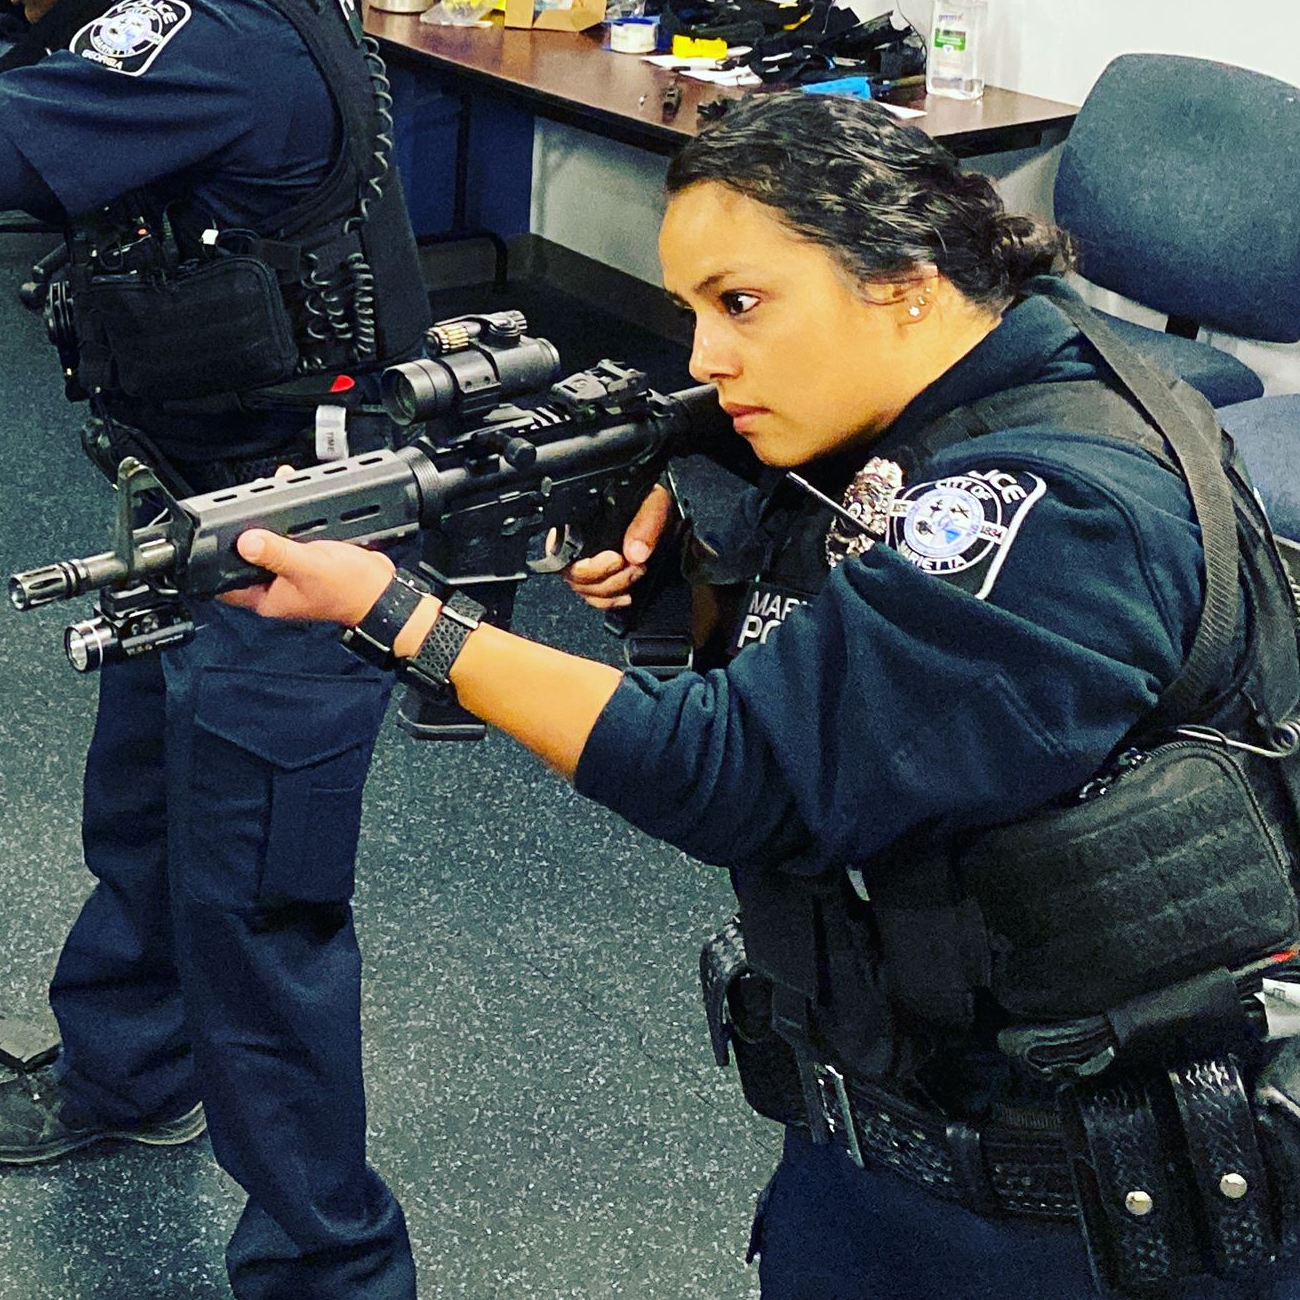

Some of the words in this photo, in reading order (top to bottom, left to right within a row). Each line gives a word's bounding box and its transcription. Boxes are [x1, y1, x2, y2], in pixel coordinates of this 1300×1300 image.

[81, 48, 124, 70] GEORGIA
[934, 478, 969, 492] CITY
[968, 484, 994, 502] OF
